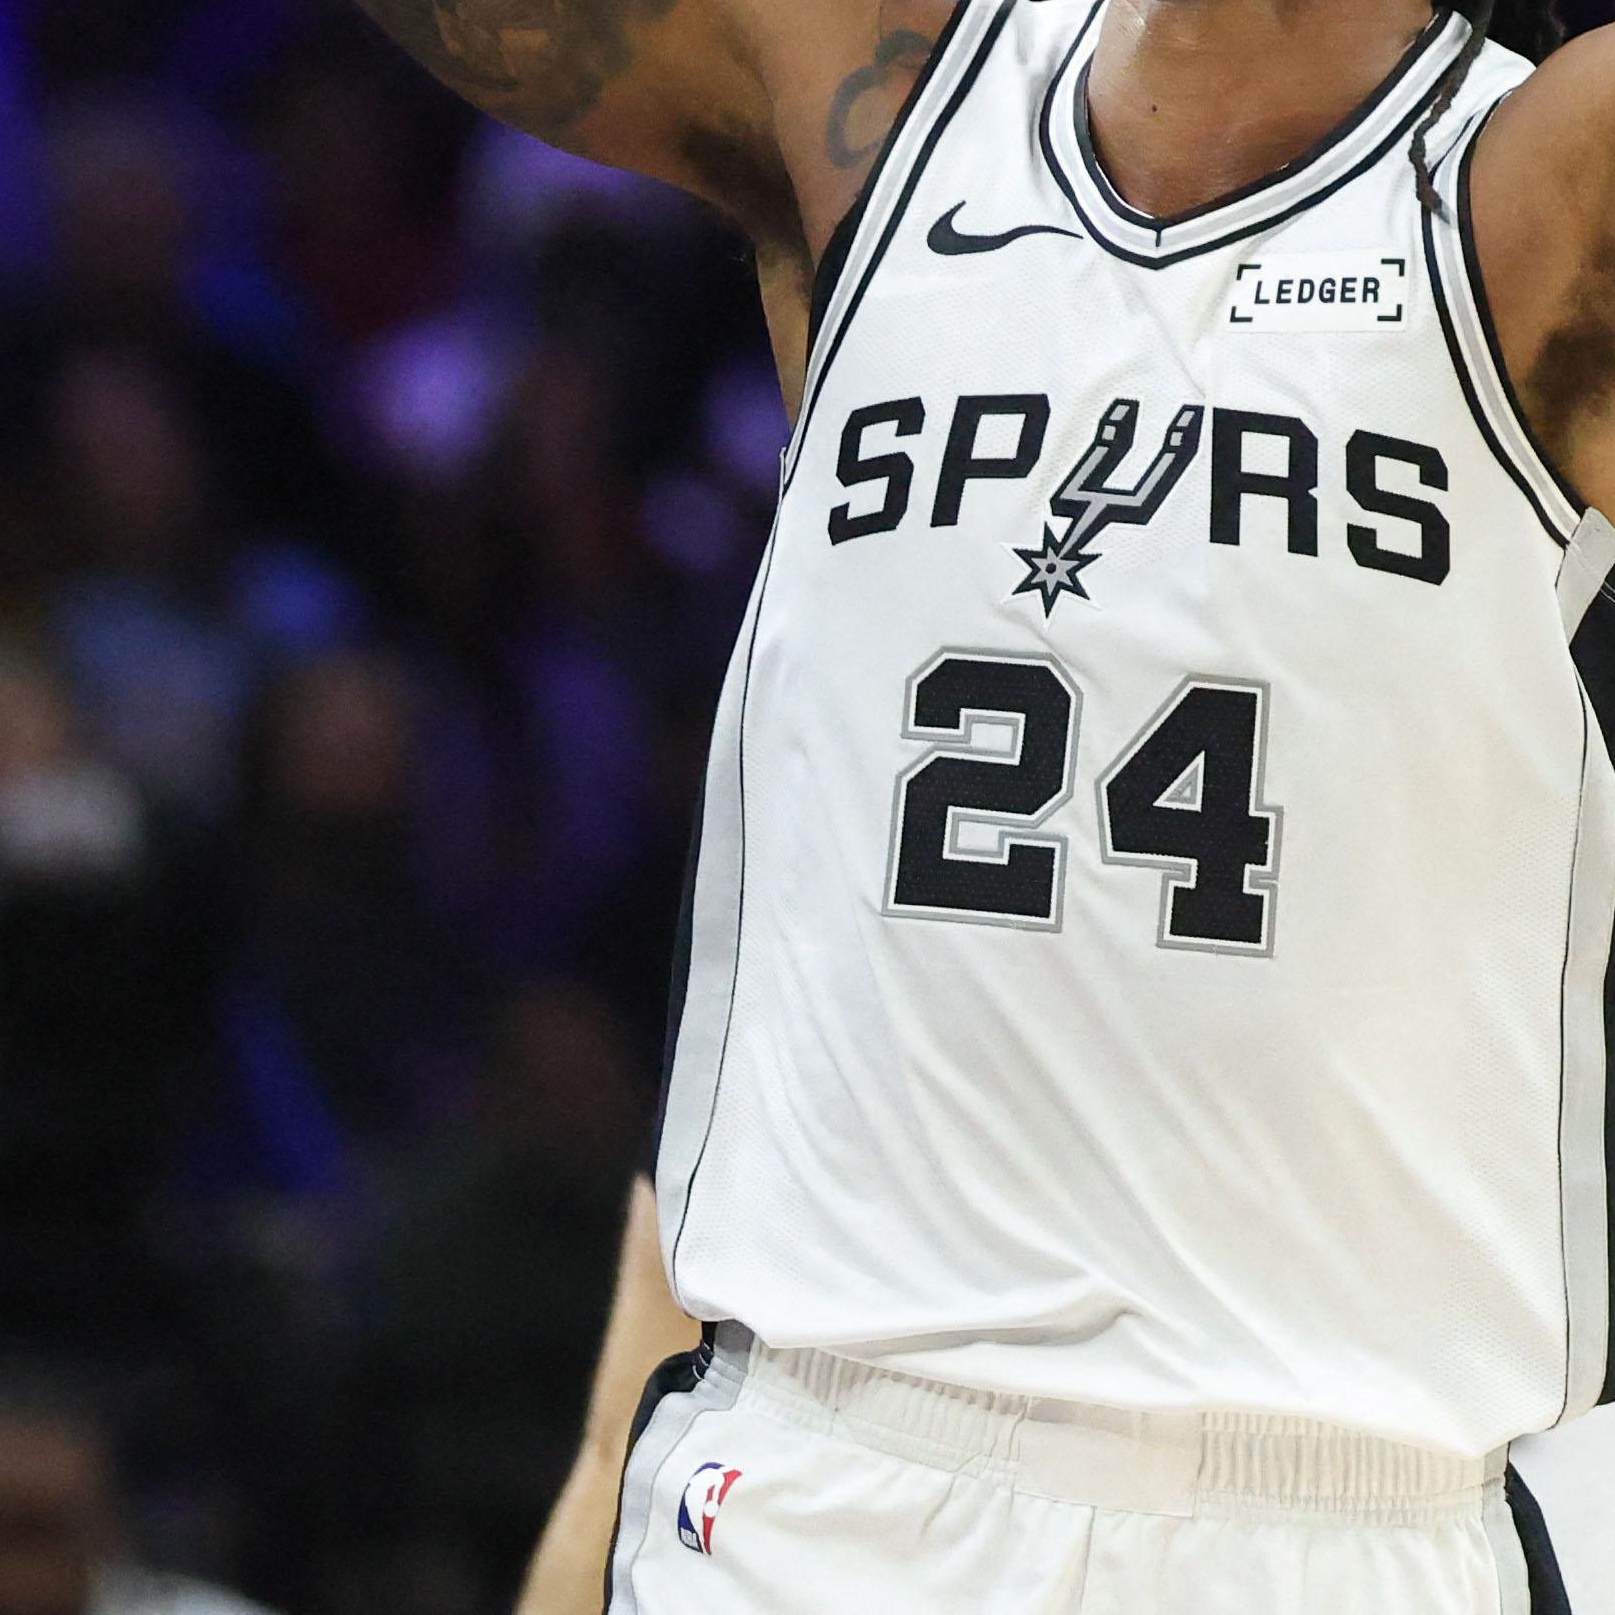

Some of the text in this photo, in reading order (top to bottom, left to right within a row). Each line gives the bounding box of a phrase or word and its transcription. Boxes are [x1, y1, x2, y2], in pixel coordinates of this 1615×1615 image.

[1254, 277, 1380, 304] LEDGER
[827, 392, 1451, 619] SPURS
[882, 646, 1284, 958] 24
